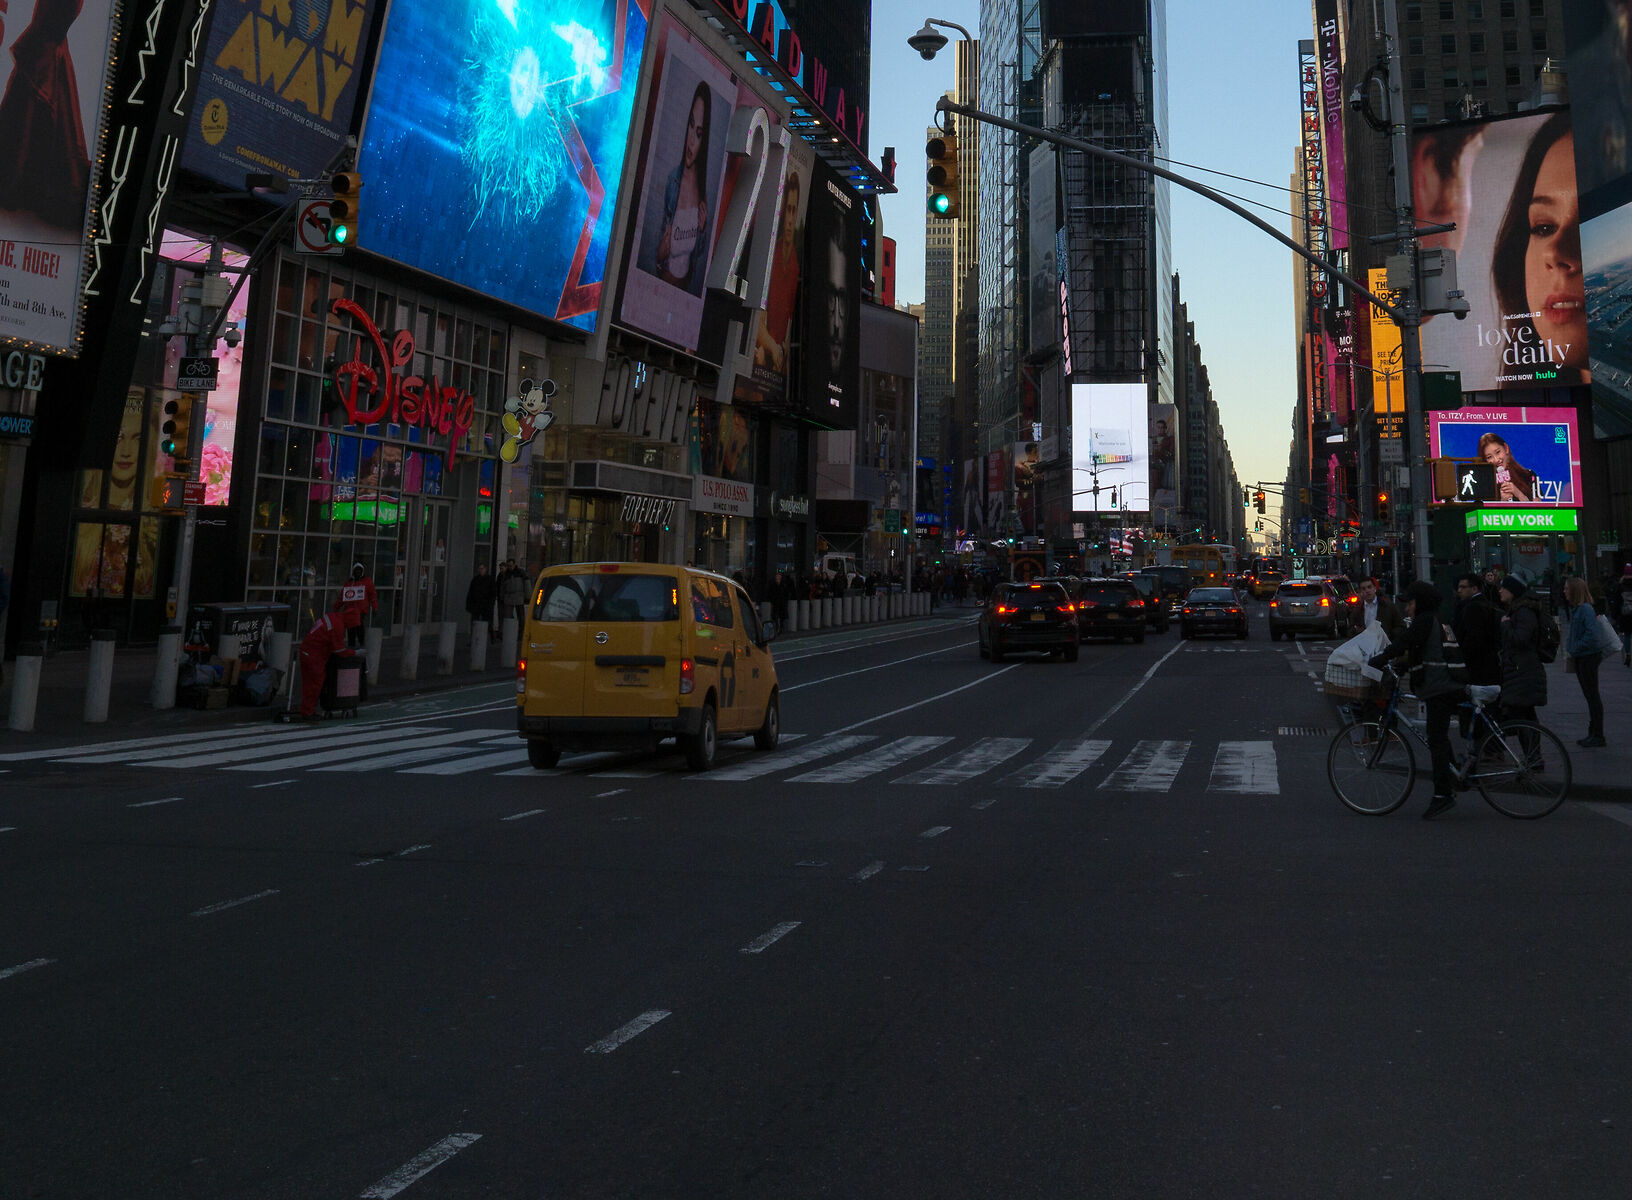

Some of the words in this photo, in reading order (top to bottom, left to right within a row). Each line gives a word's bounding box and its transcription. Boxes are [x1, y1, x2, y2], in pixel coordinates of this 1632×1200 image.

[212, 73, 224, 85] THE
[214, 11, 352, 122] AWAY
[1303, 65, 1321, 183] ERNST
[22, 246, 61, 280] HUGE!
[13, 300, 30, 312] and
[32, 301, 47, 315] 8th
[50, 308, 67, 320] Ave.
[1477, 324, 1533, 347] love
[1502, 338, 1571, 369] daily
[0, 350, 46, 392] GE
[179, 378, 195, 388] BIKE
[196, 378, 216, 388] LANE
[1496, 374, 1517, 382] WATCH
[1518, 373, 1533, 381] NOW
[1535, 370, 1557, 380] hulu
[332, 298, 475, 473] Disney
[1437, 412, 1448, 420] To.
[1448, 412, 1465, 421] ITZY,
[1466, 412, 1484, 420] From.
[1486, 412, 1492, 420] V
[1492, 412, 1508, 420] LIVE
[714, 482, 732, 500] POLO
[1530, 475, 1562, 507] itzy
[620, 495, 664, 525] FOREVER
[662, 500, 676, 527] 21
[1482, 514, 1515, 527] NEW
[1517, 514, 1555, 527] YORK
